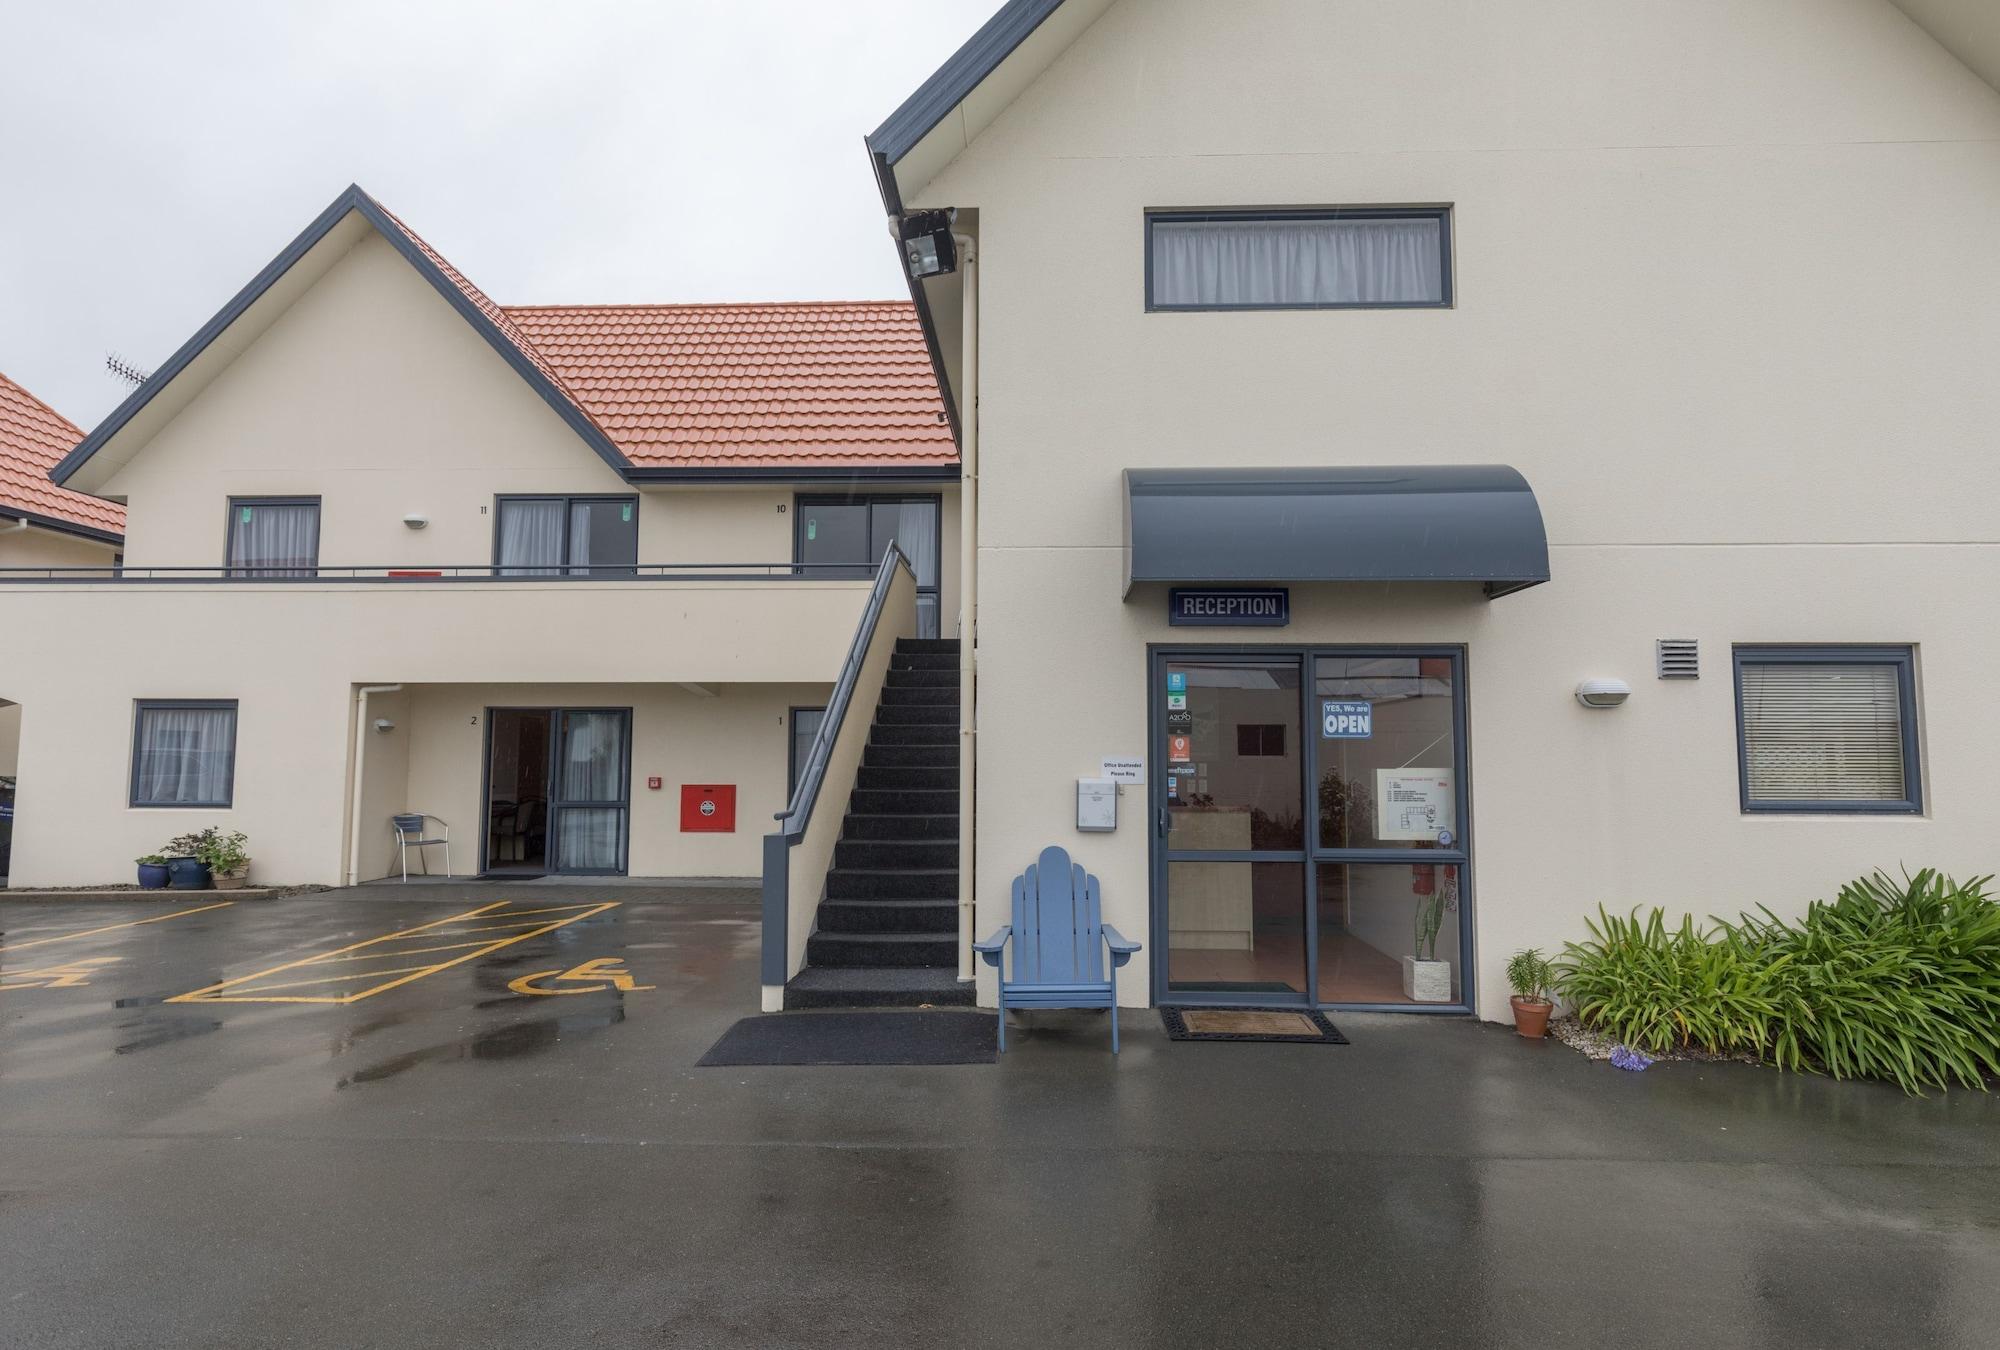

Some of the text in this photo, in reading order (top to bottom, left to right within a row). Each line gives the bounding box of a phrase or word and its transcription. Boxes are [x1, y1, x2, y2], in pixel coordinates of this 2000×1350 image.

[480, 506, 487, 515] 11
[776, 504, 786, 513] 10
[1183, 597, 1276, 615] RECEPTION
[1325, 704, 1342, 713] YES,
[1343, 704, 1355, 712] We
[471, 716, 477, 725] 2
[1325, 715, 1369, 733] OPEN
